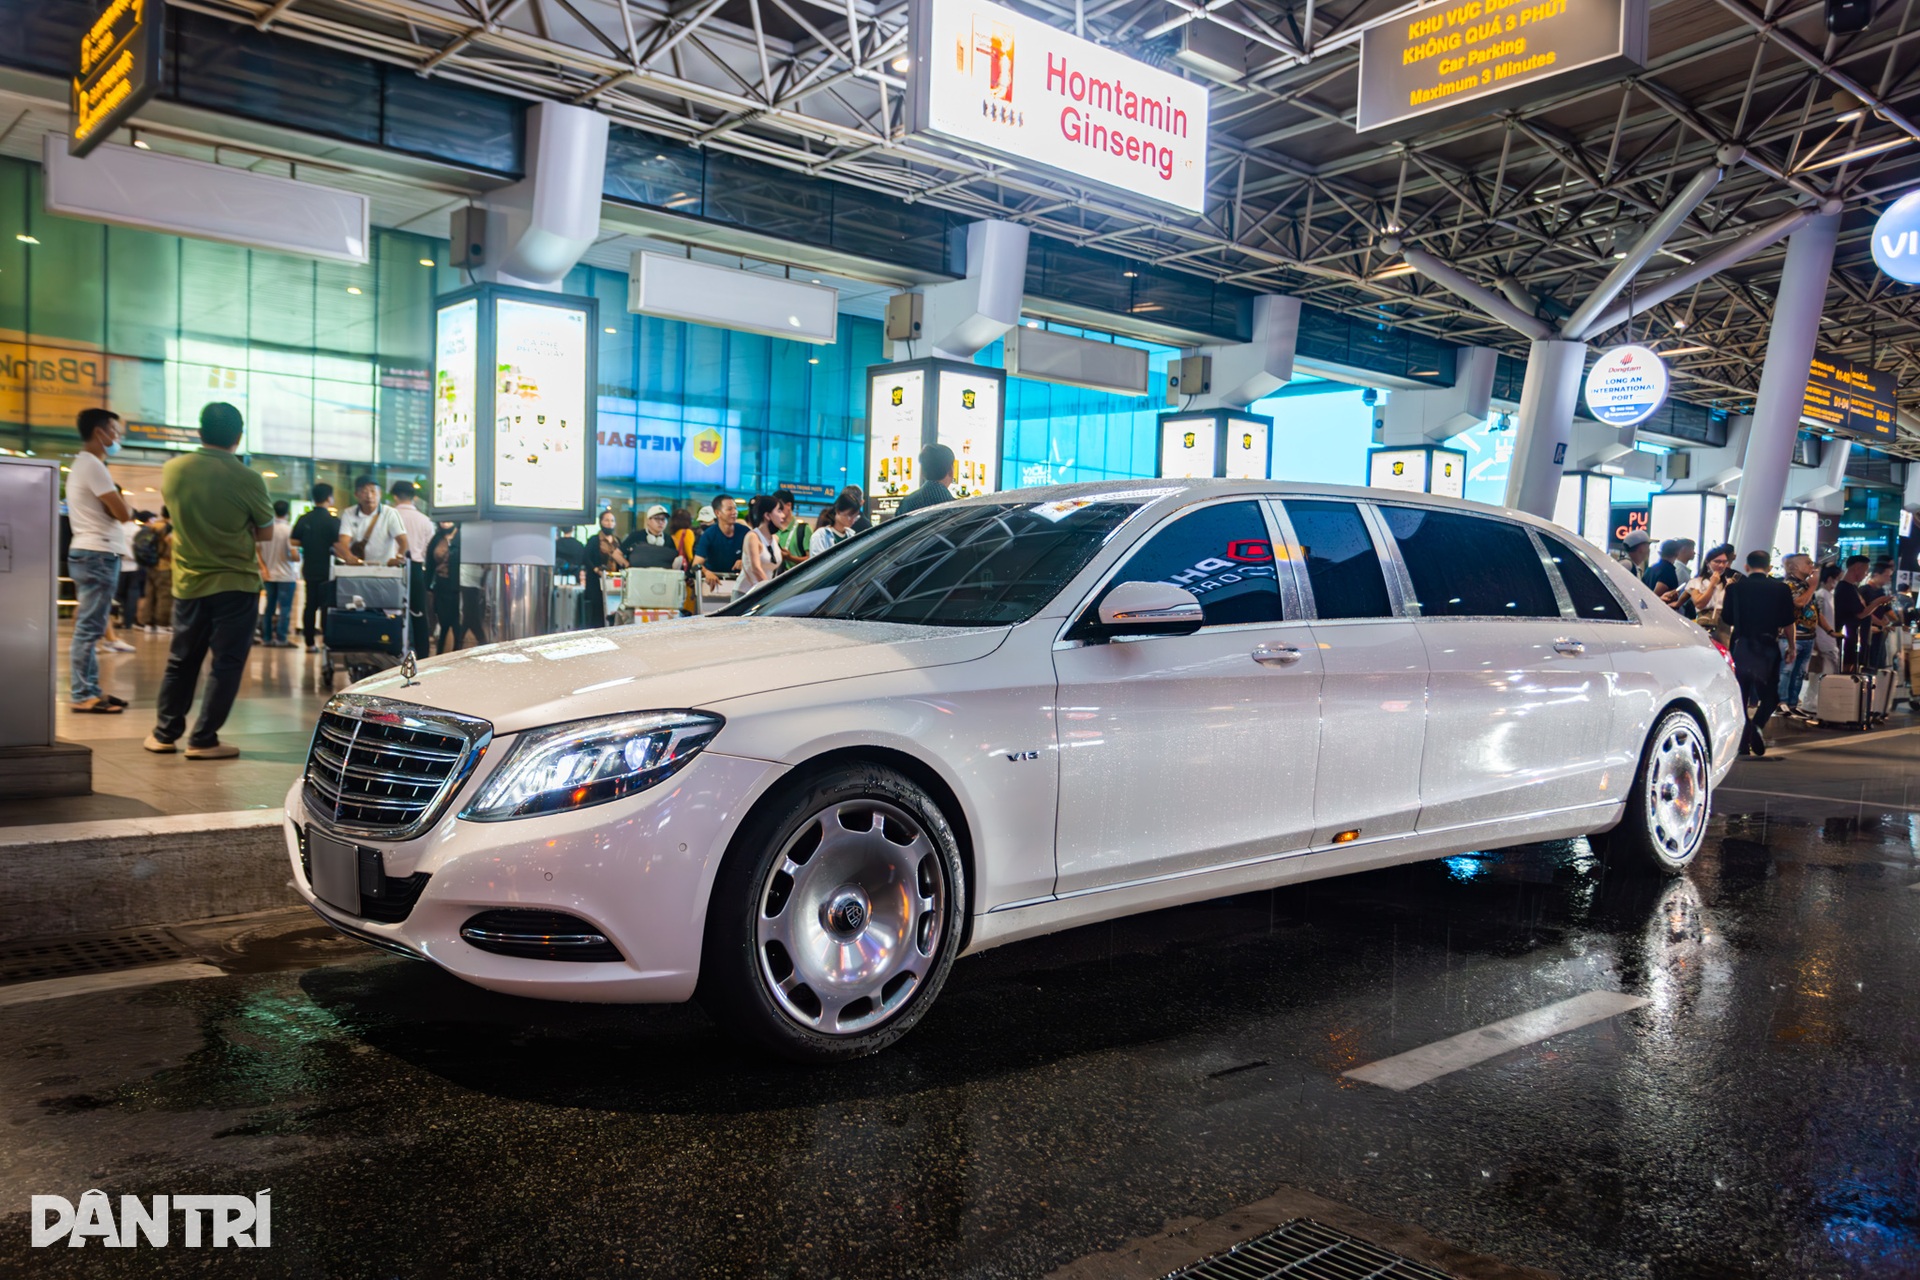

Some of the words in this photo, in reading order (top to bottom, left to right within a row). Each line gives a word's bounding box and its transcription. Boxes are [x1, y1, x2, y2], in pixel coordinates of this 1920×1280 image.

[1403, 32, 1463, 66] KHÔNG
[1464, 14, 1503, 45] QUÁ
[1505, 13, 1517, 31] 3
[1408, 14, 1444, 41] KHU
[1446, 2, 1482, 26] VỰC
[1409, 74, 1479, 106] Maximum
[1481, 68, 1493, 85] 3
[1494, 51, 1557, 81] Minutes
[1438, 56, 1467, 75] Car
[1467, 37, 1527, 67] Parking
[1046, 52, 1187, 138] Homtamin
[1060, 106, 1174, 181] Ginseng
[1605, 377, 1628, 385] LONG
